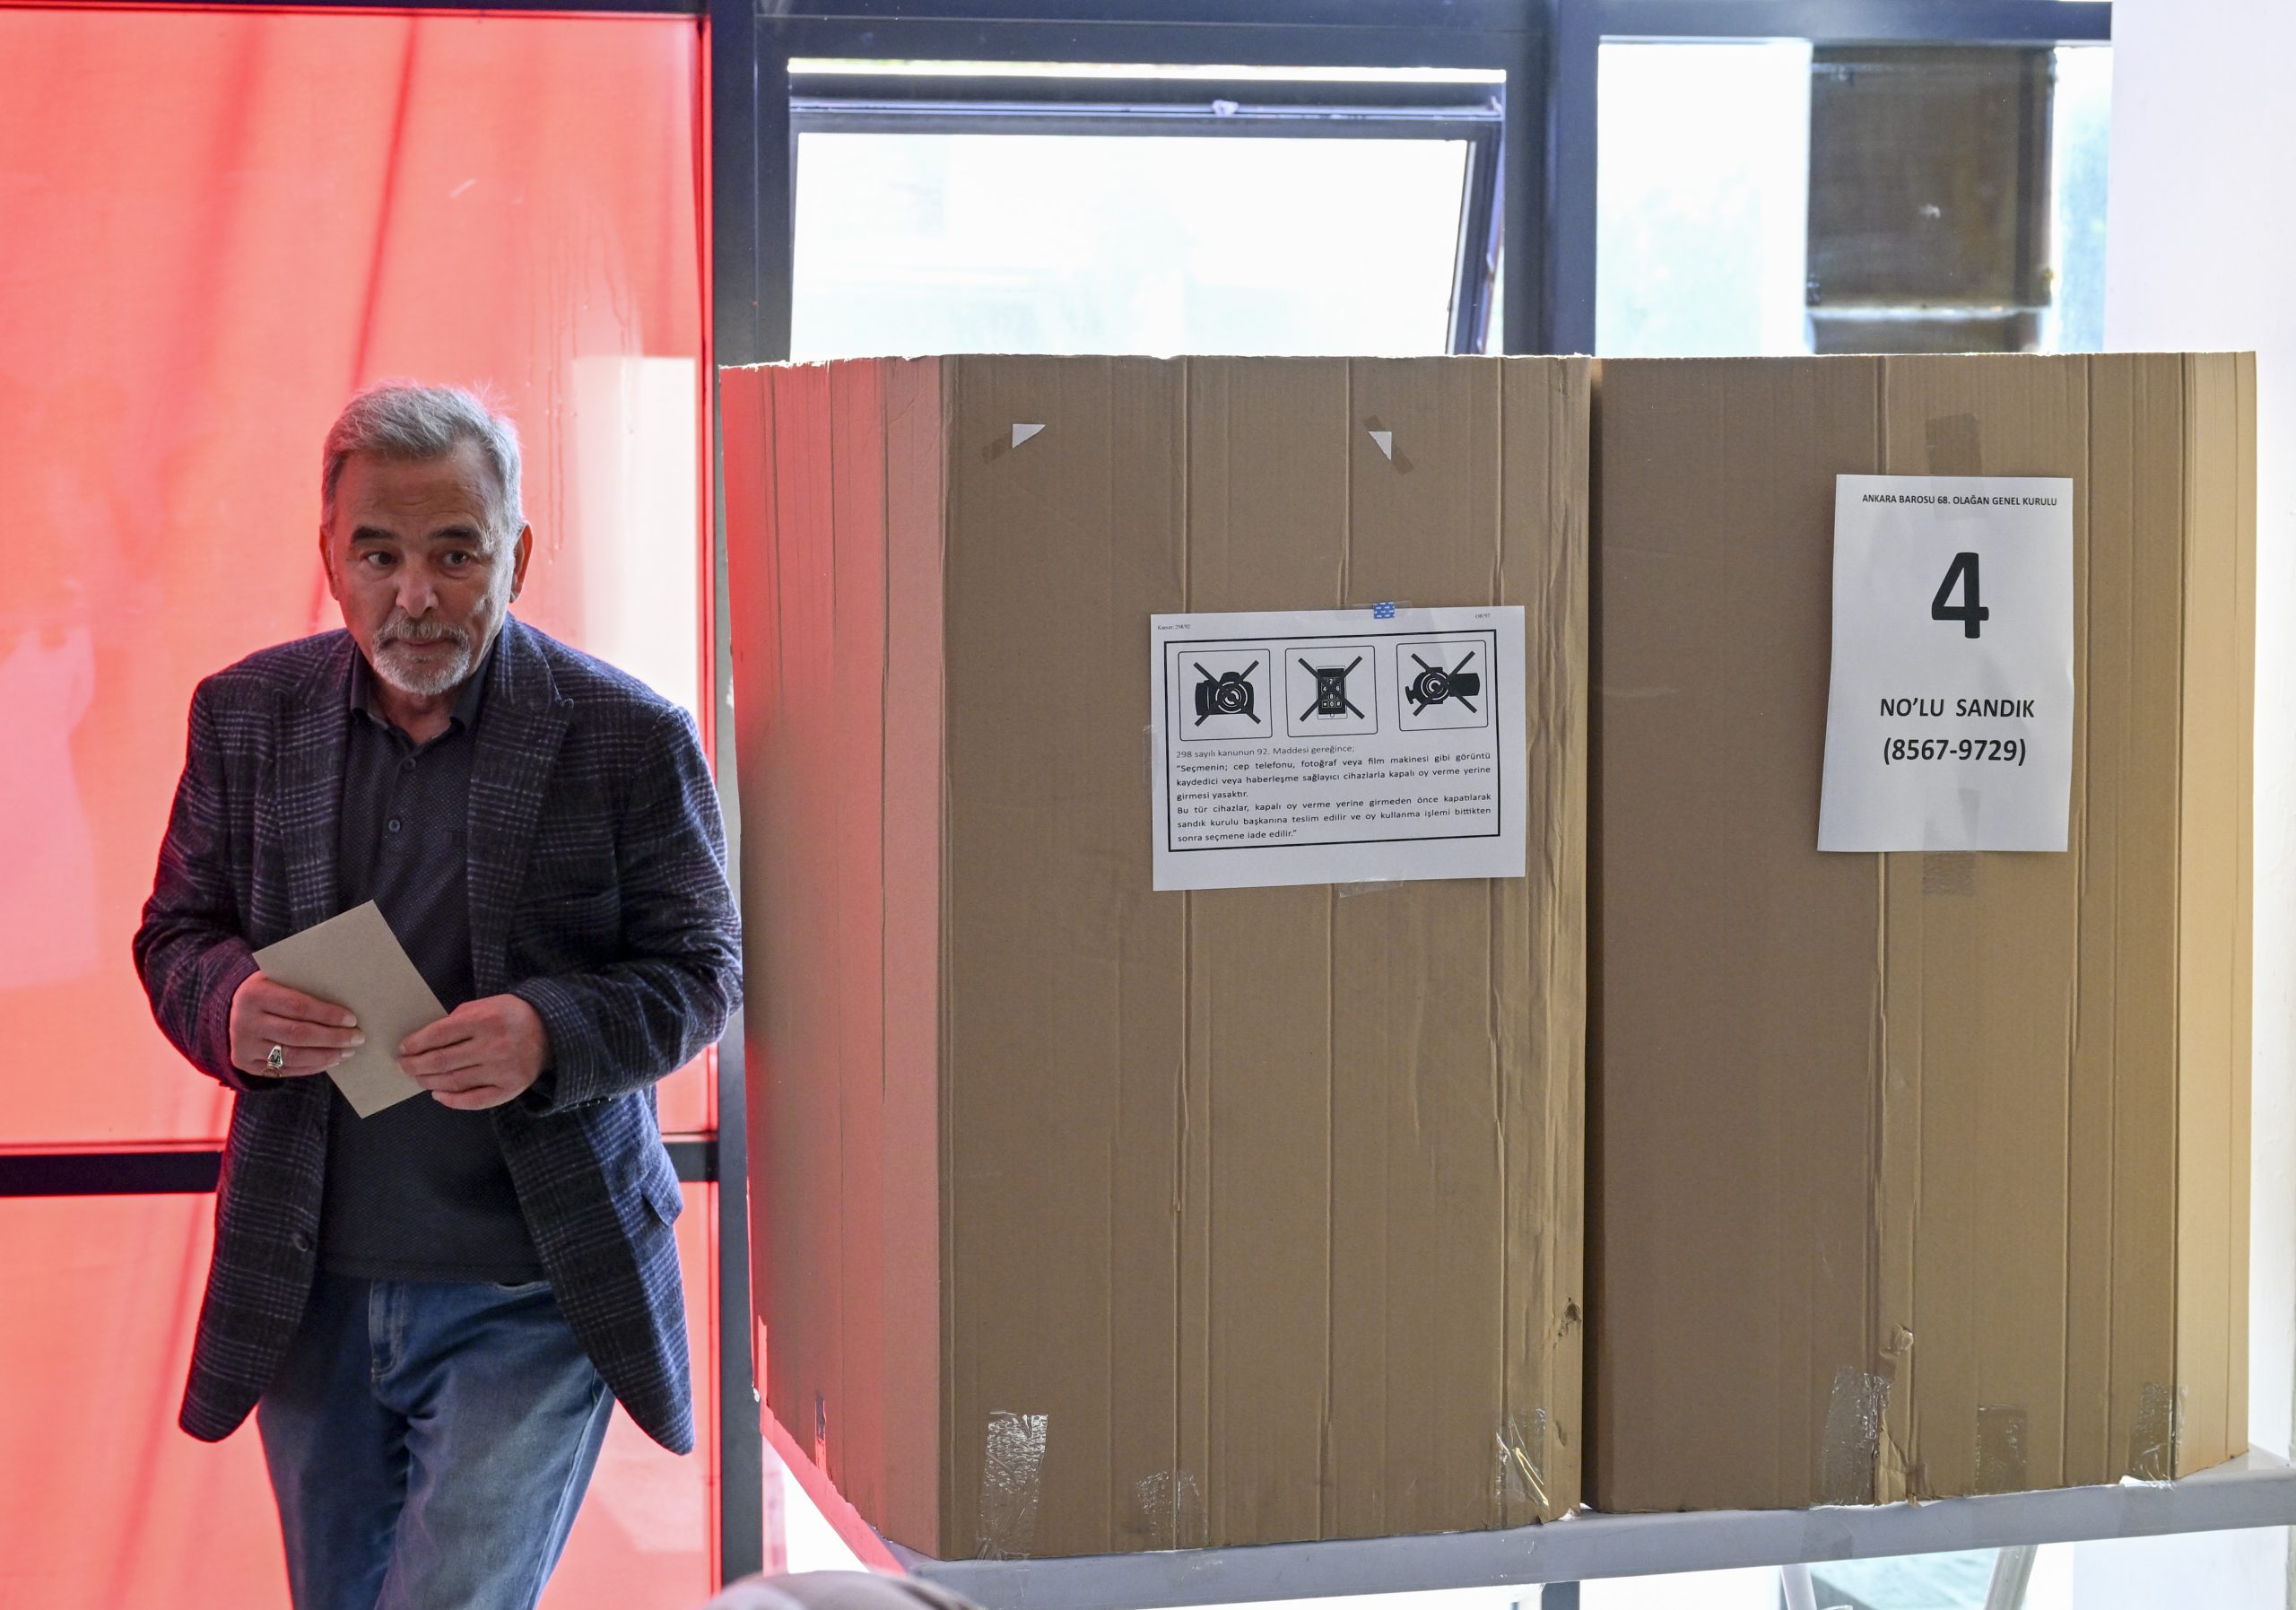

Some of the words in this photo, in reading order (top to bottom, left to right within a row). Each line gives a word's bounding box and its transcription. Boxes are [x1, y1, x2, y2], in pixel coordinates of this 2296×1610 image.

[1862, 494, 1897, 503] ANKARA
[1900, 495, 1935, 504] BAROSU
[1937, 495, 1951, 504] 68.
[1952, 494, 1989, 505] OLAĞAN
[1992, 496, 2020, 505] GENEL
[2022, 497, 2057, 506] KURULU
[1931, 553, 1989, 639] 4
[1956, 700, 2034, 718] SANDIK
[1274, 746, 1309, 754] Maddesi
[1311, 745, 1355, 754] gereğince;
[1883, 738, 2026, 765] (8567-9729)
[1256, 761, 1295, 770] telefonu,
[1301, 759, 1337, 768] fotoğraf
[1391, 755, 1429, 763] makinesi
[1434, 754, 1450, 762] gibi
[1456, 753, 1491, 761] görüntü
[1177, 779, 1218, 787] kaydedici
[1246, 775, 1299, 783] haberleşme
[1302, 773, 1340, 782] sağlayıcı
[1344, 771, 1385, 779] cihazlarla
[1389, 770, 1415, 779] kapalı
[1464, 766, 1491, 775] yerine
[1177, 792, 1210, 801] girmesi
[1213, 791, 1248, 799] yasaktır.
[1213, 805, 1249, 813] cihazlar,
[1256, 803, 1281, 811] kapalı
[1336, 799, 1364, 808] yerine
[1370, 797, 1412, 806] girmeden
[1444, 794, 1491, 802] kapatılarak
[1178, 820, 1206, 828] sandık
[1211, 818, 1239, 826] kurulu
[1244, 817, 1287, 826] başkanına
[1292, 814, 1318, 822] teslim
[1324, 814, 1346, 822] edilir
[1424, 809, 1450, 817] işlemi
[1205, 833, 1245, 841] seçmene
